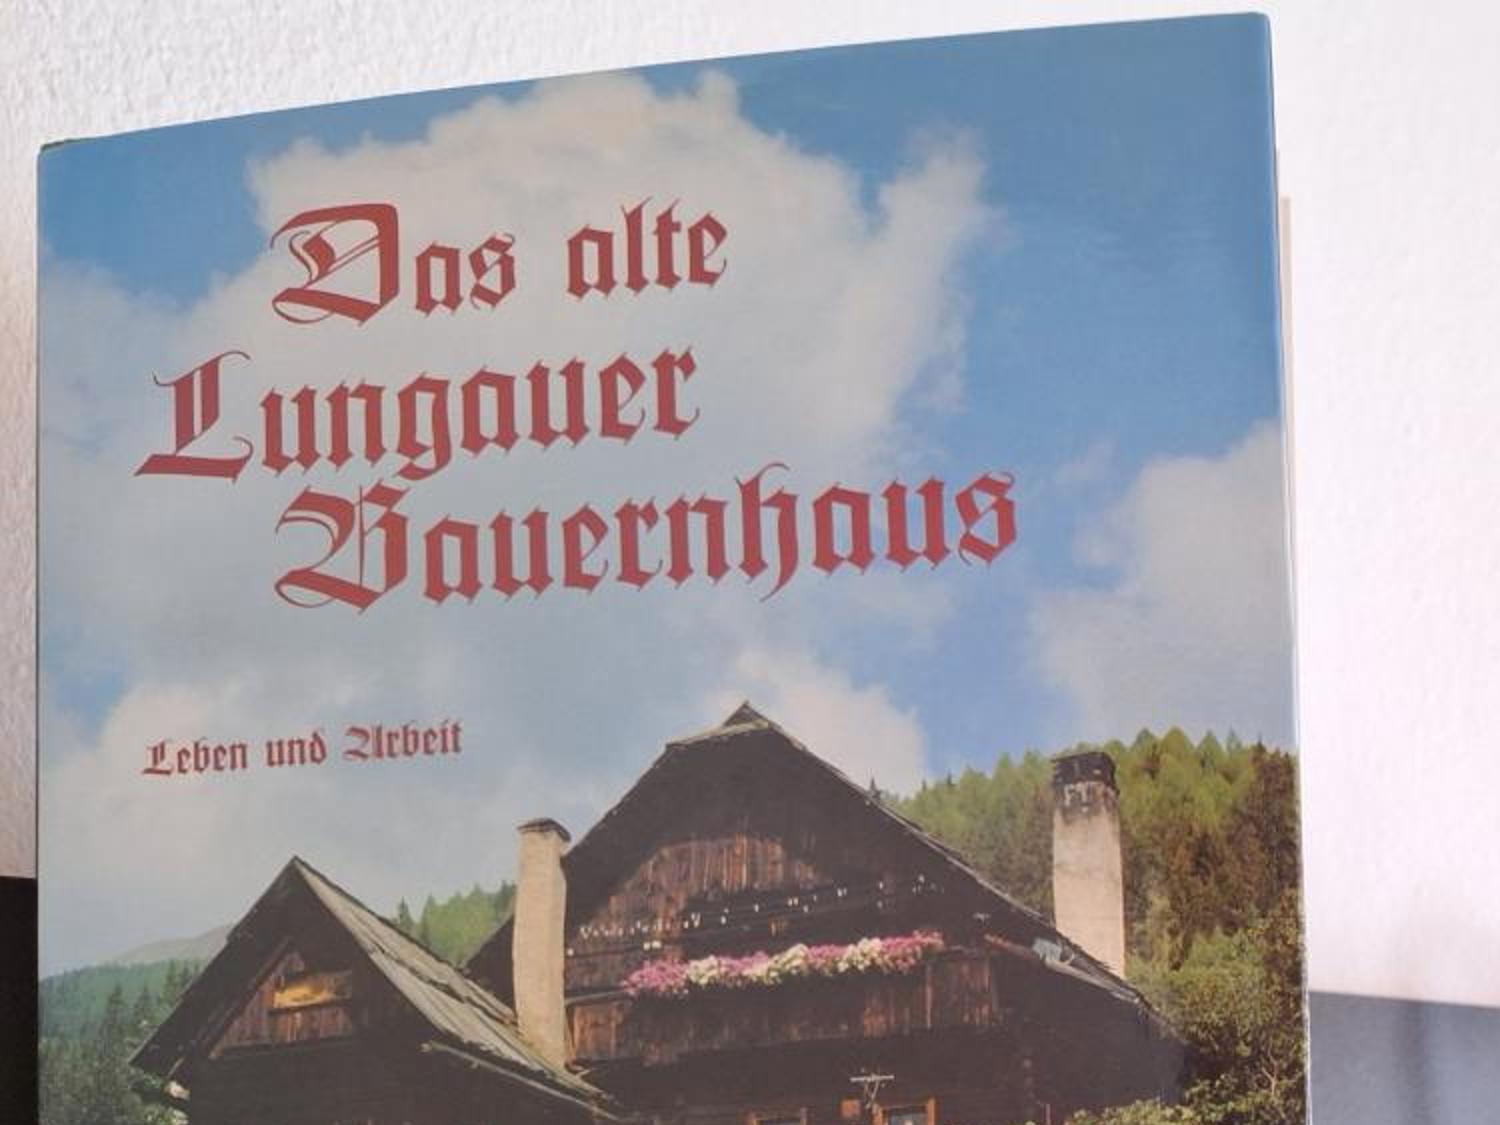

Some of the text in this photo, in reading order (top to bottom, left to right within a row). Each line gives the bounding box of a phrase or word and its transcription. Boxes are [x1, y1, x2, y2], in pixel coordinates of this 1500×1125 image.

[271, 197, 728, 324] Das alte
[134, 344, 701, 484] Lungauer
[273, 462, 1018, 613] Bauernhaus
[141, 719, 463, 776] Leben und Arbeit
